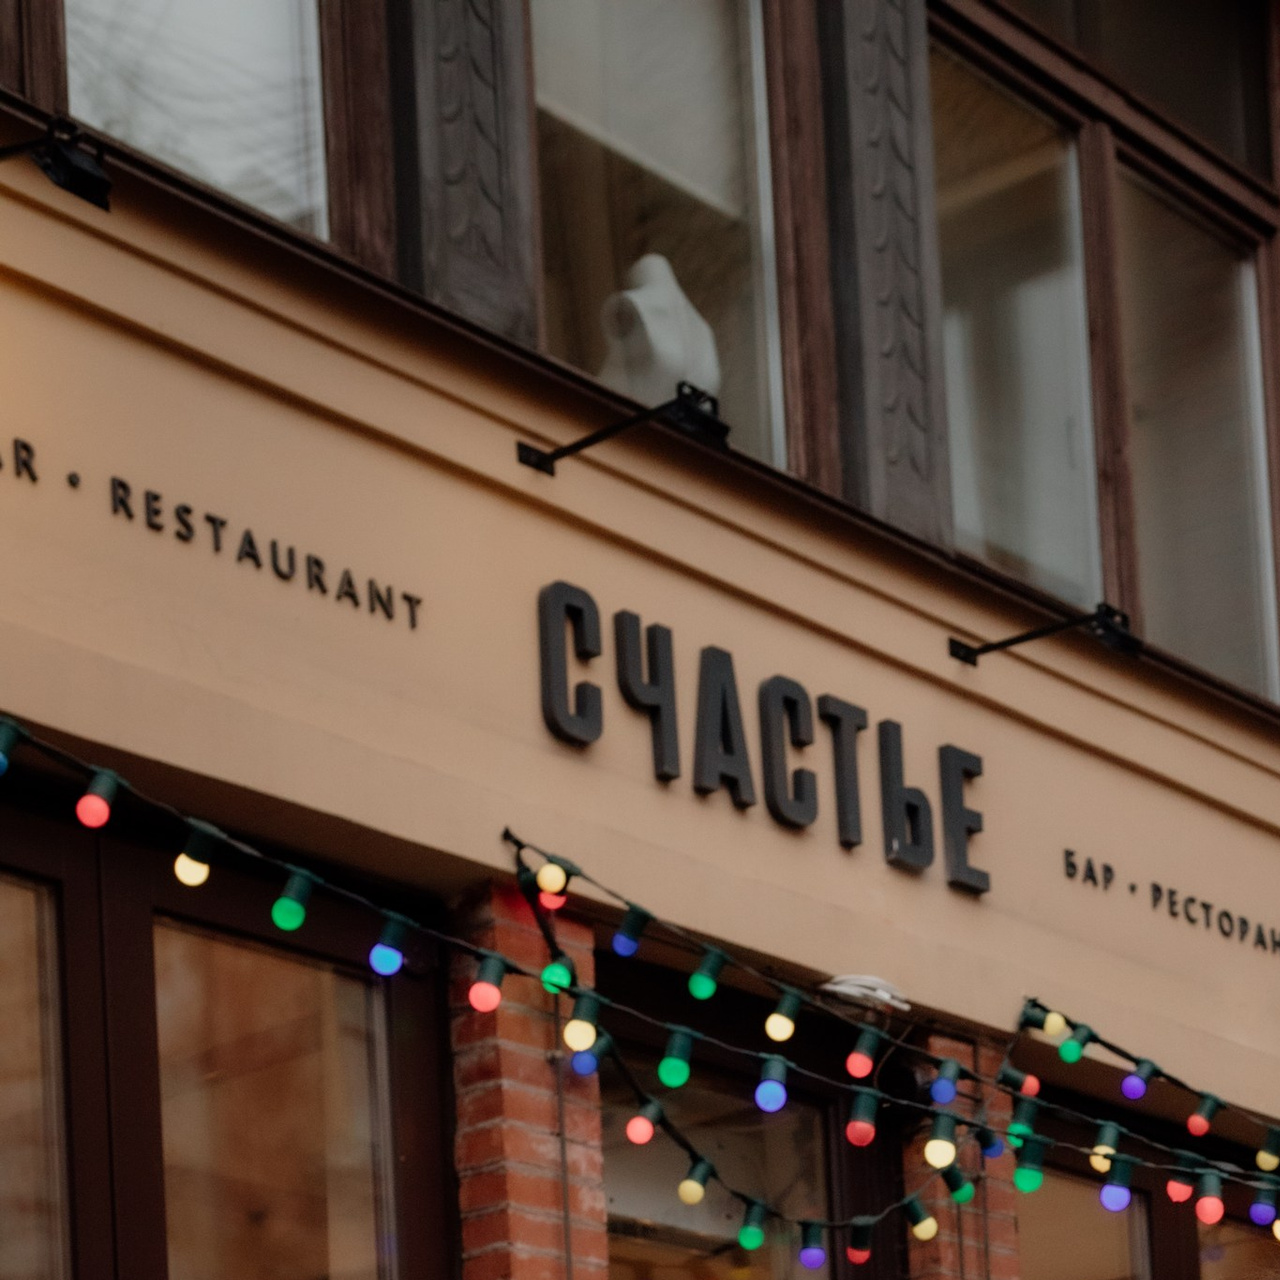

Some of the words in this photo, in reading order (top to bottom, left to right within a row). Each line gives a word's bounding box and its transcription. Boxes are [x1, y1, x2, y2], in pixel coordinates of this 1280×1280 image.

[0, 437, 39, 484] R
[110, 475, 423, 630] RESTAURANT
[536, 579, 991, 897] СЧАСТЬЕ
[1064, 848, 1115, 891] БАР
